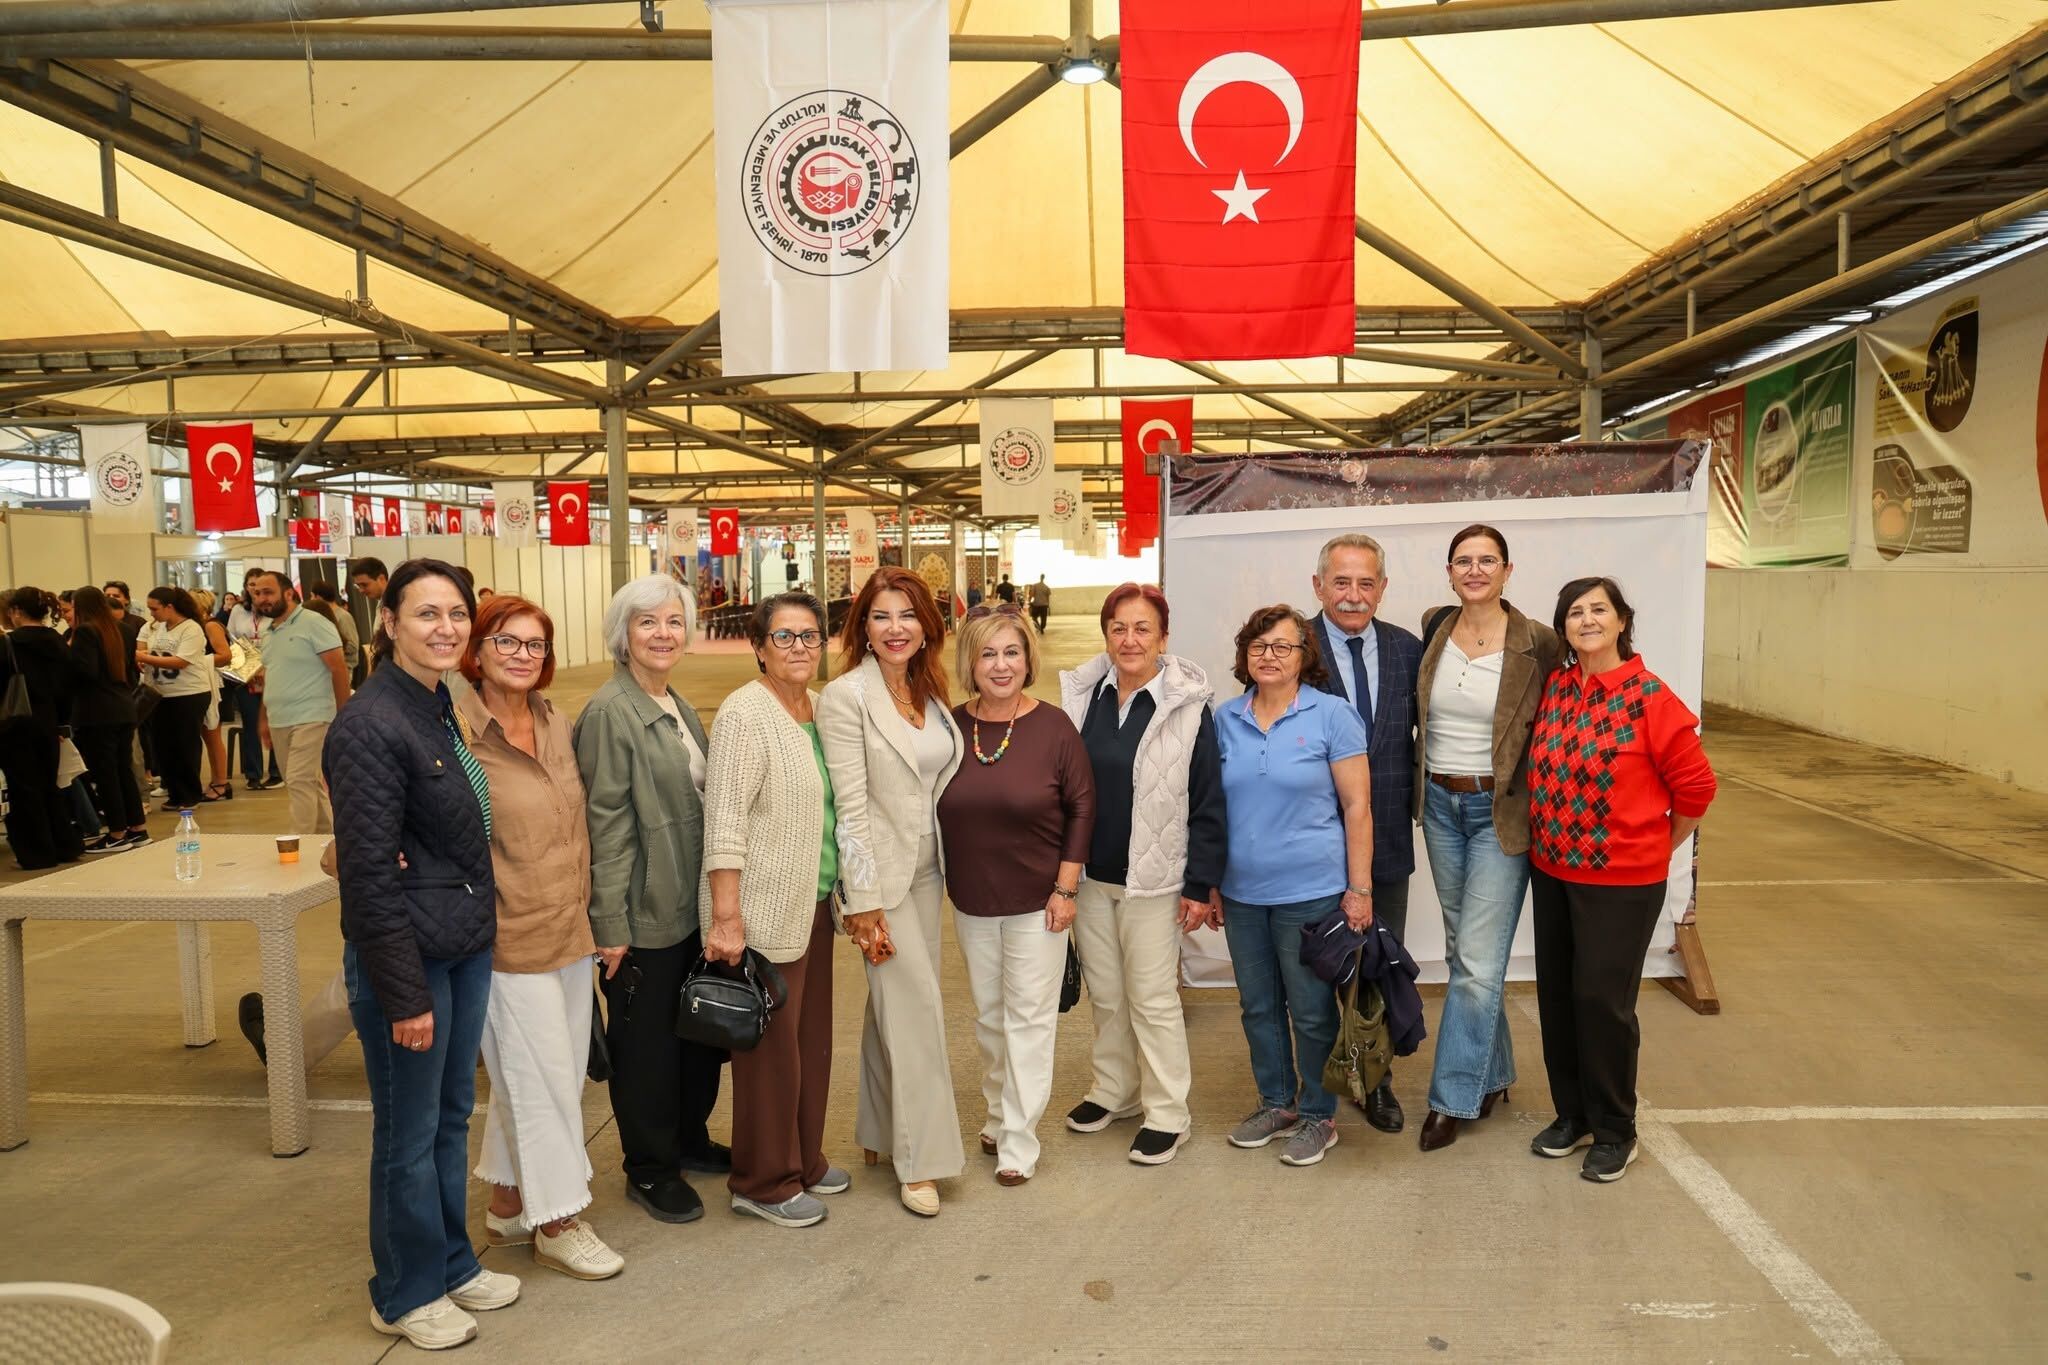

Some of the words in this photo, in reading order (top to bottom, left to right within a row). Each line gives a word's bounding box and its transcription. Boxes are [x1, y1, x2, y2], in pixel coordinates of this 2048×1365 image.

[778, 103, 826, 130] KÜLTÜR
[763, 128, 781, 145] VE
[750, 144, 769, 219] MEDENİYET
[761, 220, 795, 253] ŞEHRİ
[800, 248, 828, 264] 1870
